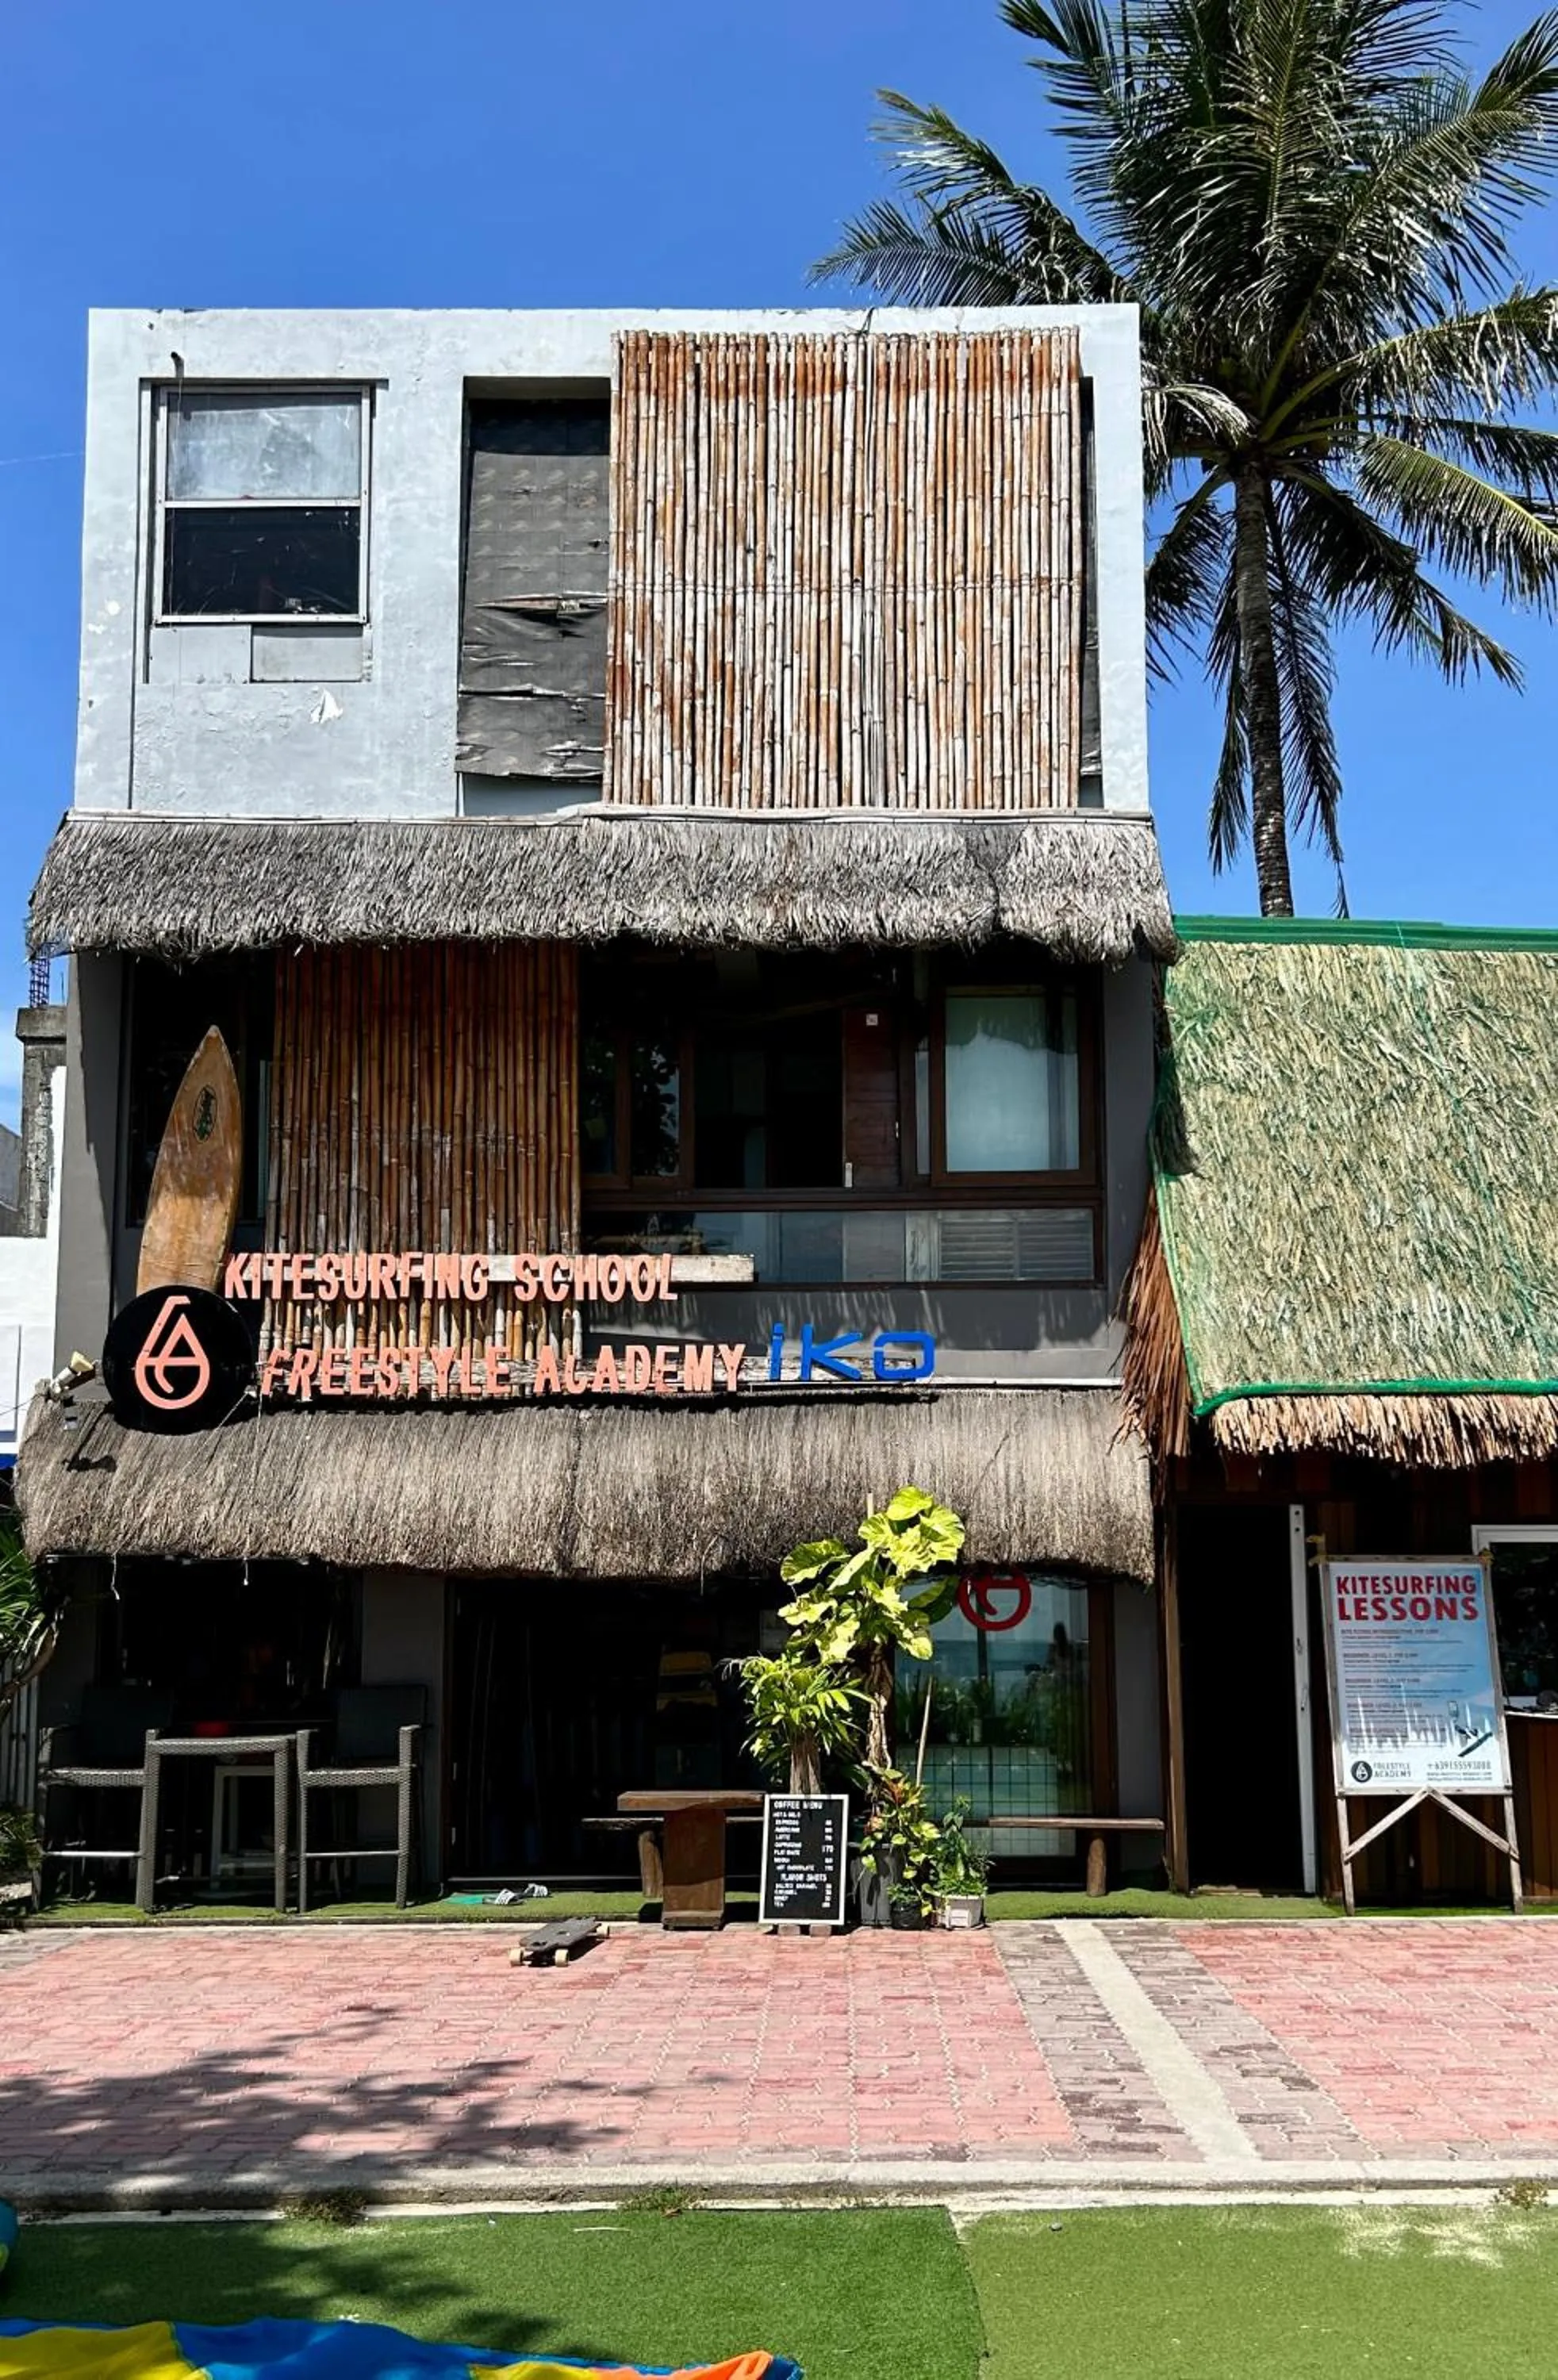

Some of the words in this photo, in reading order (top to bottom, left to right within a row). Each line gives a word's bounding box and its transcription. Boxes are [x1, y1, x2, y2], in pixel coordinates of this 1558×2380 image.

[224, 1252, 489, 1302] KITESURFING
[514, 1253, 677, 1302] SCHOOL
[260, 1345, 512, 1396] FREESTYLE
[533, 1343, 746, 1394] ACADEMY
[1335, 1576, 1476, 1595] KITESURFING
[1337, 1597, 1479, 1621] LESSONS
[773, 1801, 800, 1810] COFFEE
